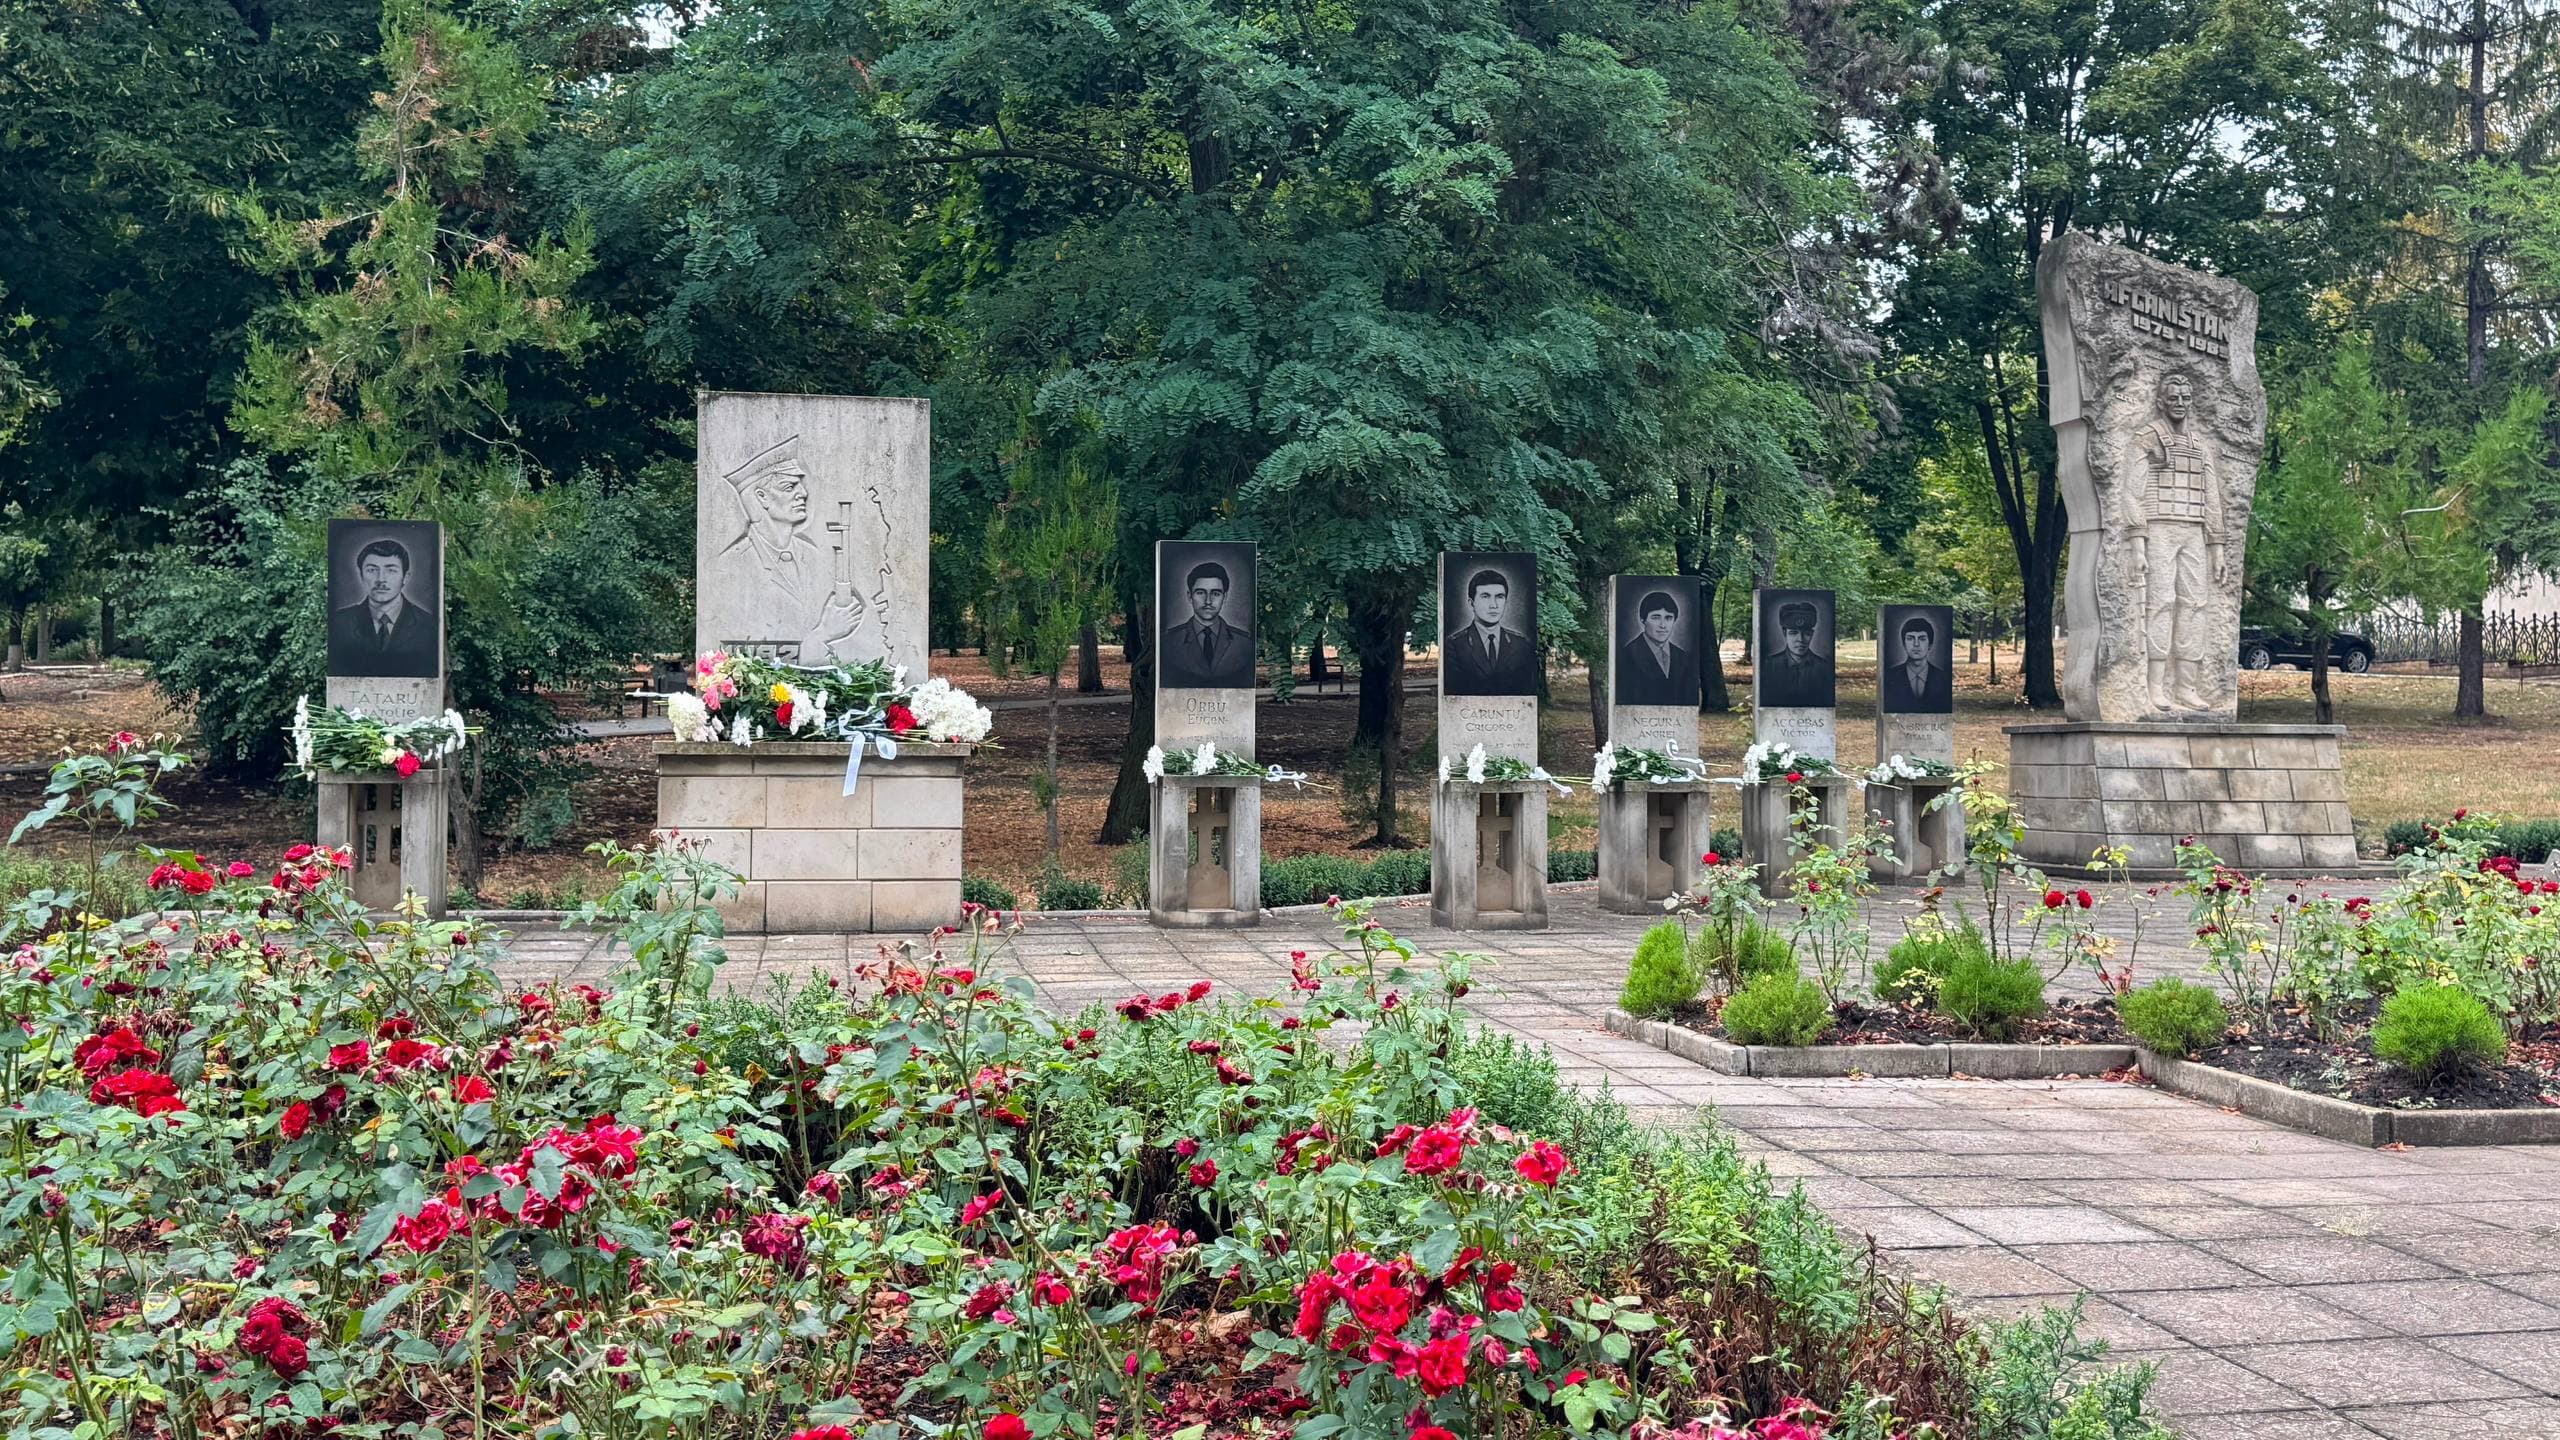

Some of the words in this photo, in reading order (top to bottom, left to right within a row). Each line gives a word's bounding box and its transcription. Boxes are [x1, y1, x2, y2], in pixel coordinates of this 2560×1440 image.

[2132, 313, 2174, 340] 1979
[349, 690, 418, 705] TATARU
[1186, 697, 1226, 713] ORBU
